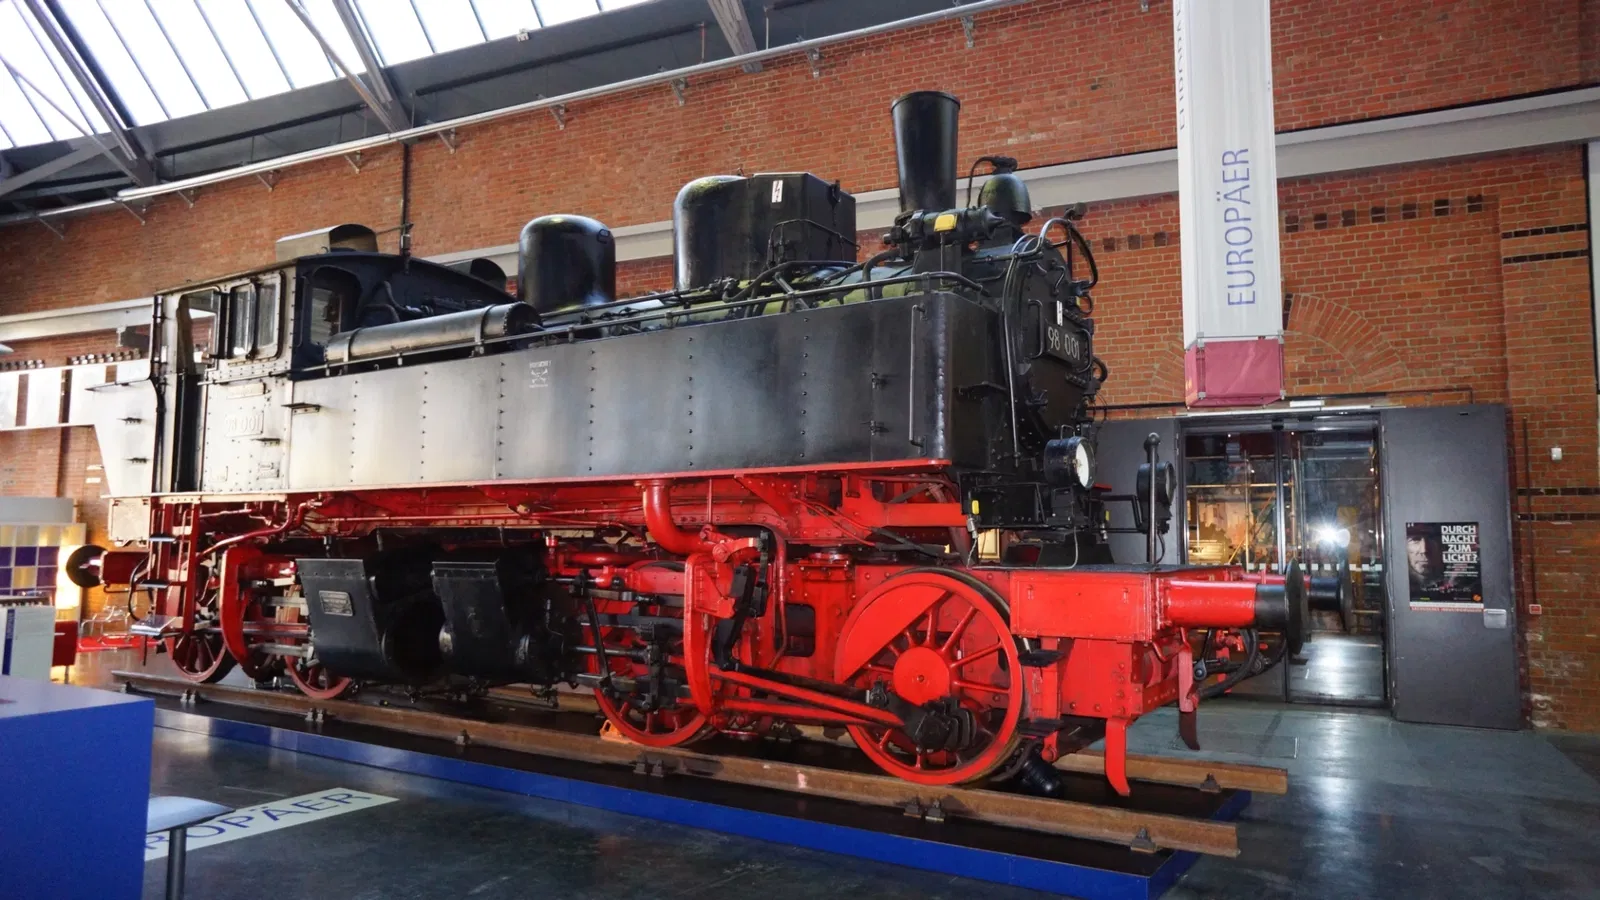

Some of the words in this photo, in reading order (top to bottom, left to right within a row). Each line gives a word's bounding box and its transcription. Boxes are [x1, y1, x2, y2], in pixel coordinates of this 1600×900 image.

[1216, 148, 1256, 307] EUROPÄER
[1048, 326, 1060, 351] 98
[1064, 333, 1080, 361] 001
[1441, 525, 1476, 534] DURCH
[1441, 534, 1476, 543] NACHT
[1448, 544, 1472, 552] ZUM
[1442, 554, 1478, 562] LICHT?
[145, 792, 372, 850] ROPÄER
